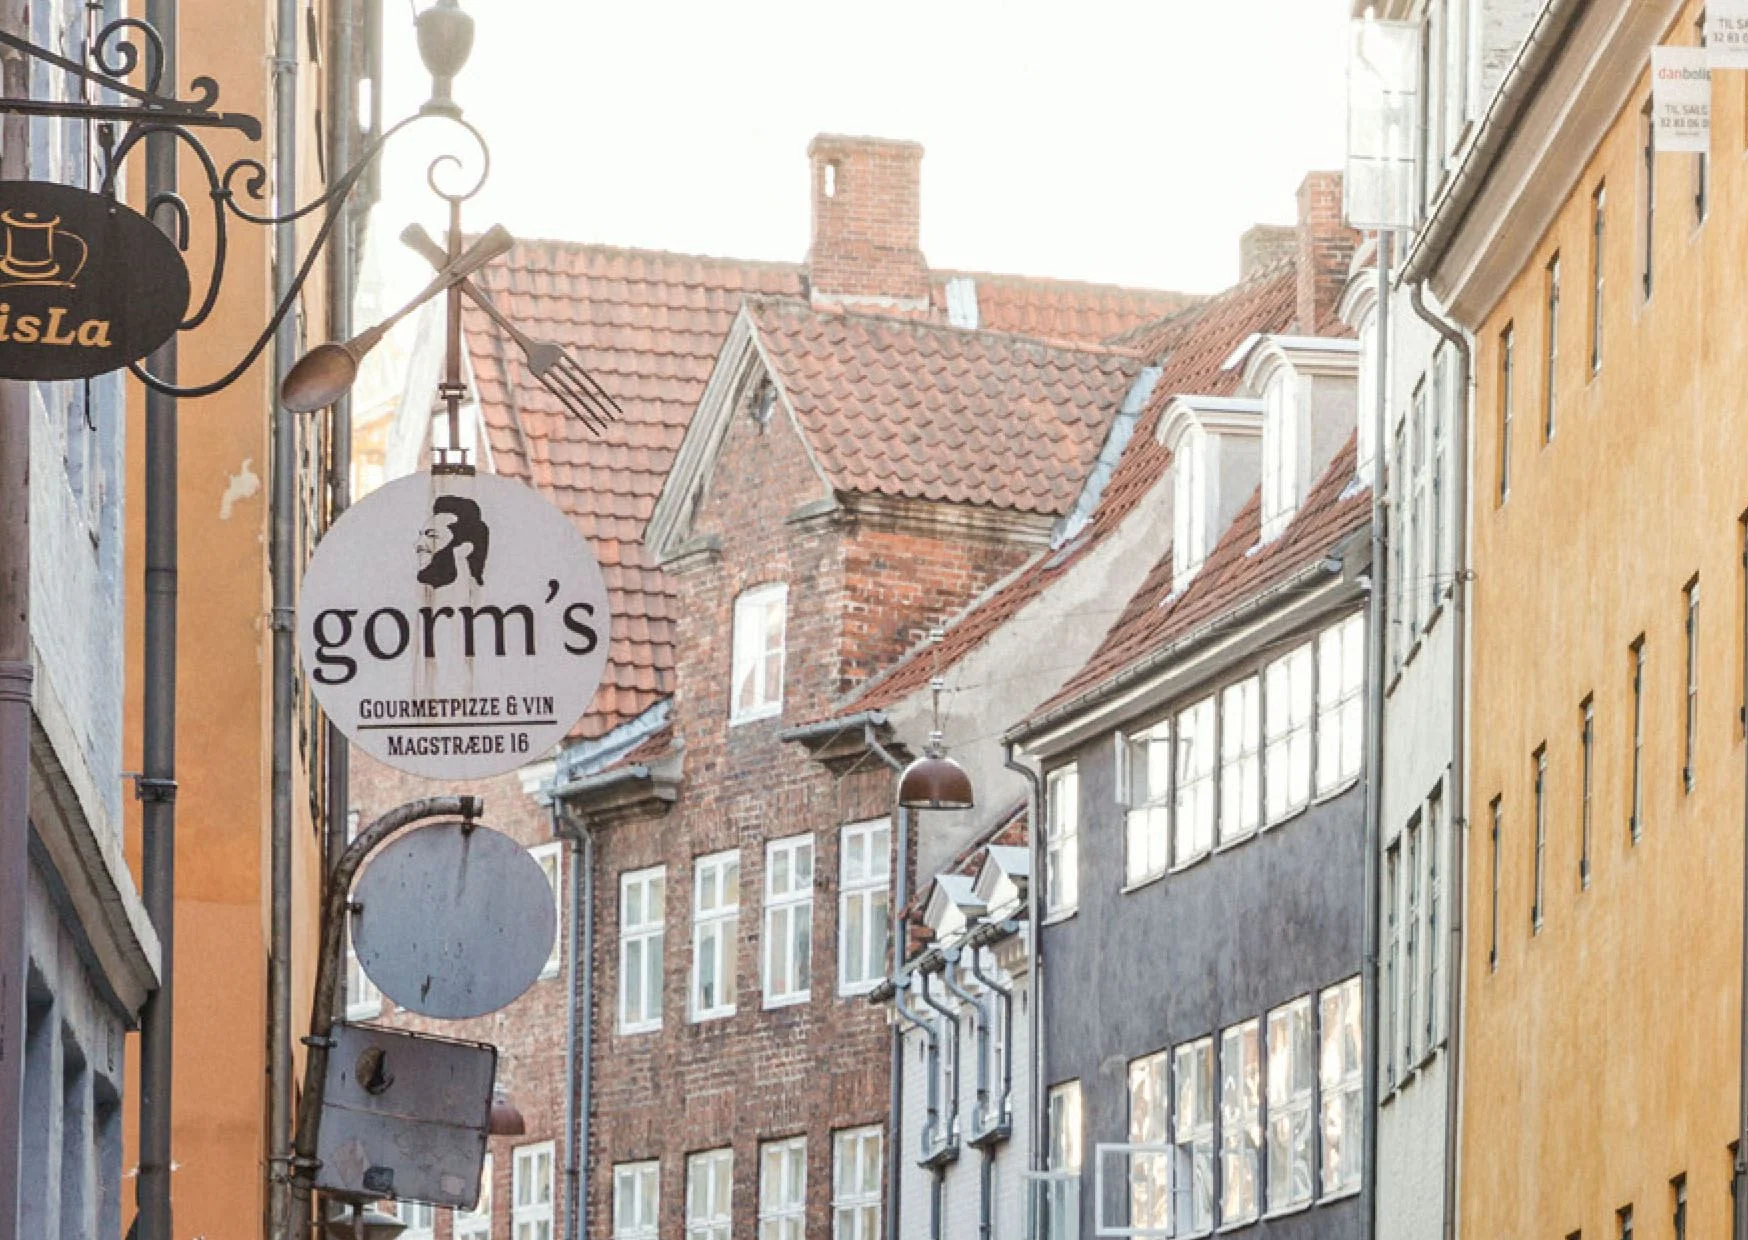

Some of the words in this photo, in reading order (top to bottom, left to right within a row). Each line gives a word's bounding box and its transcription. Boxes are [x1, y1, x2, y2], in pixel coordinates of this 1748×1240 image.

[312, 579, 598, 684] gorm's
[359, 697, 500, 719] GOURMETPIZZE
[506, 695, 518, 716] &
[522, 696, 555, 715] VIN
[387, 735, 505, 756] MAGSTRÆDE
[510, 733, 530, 753] 16
